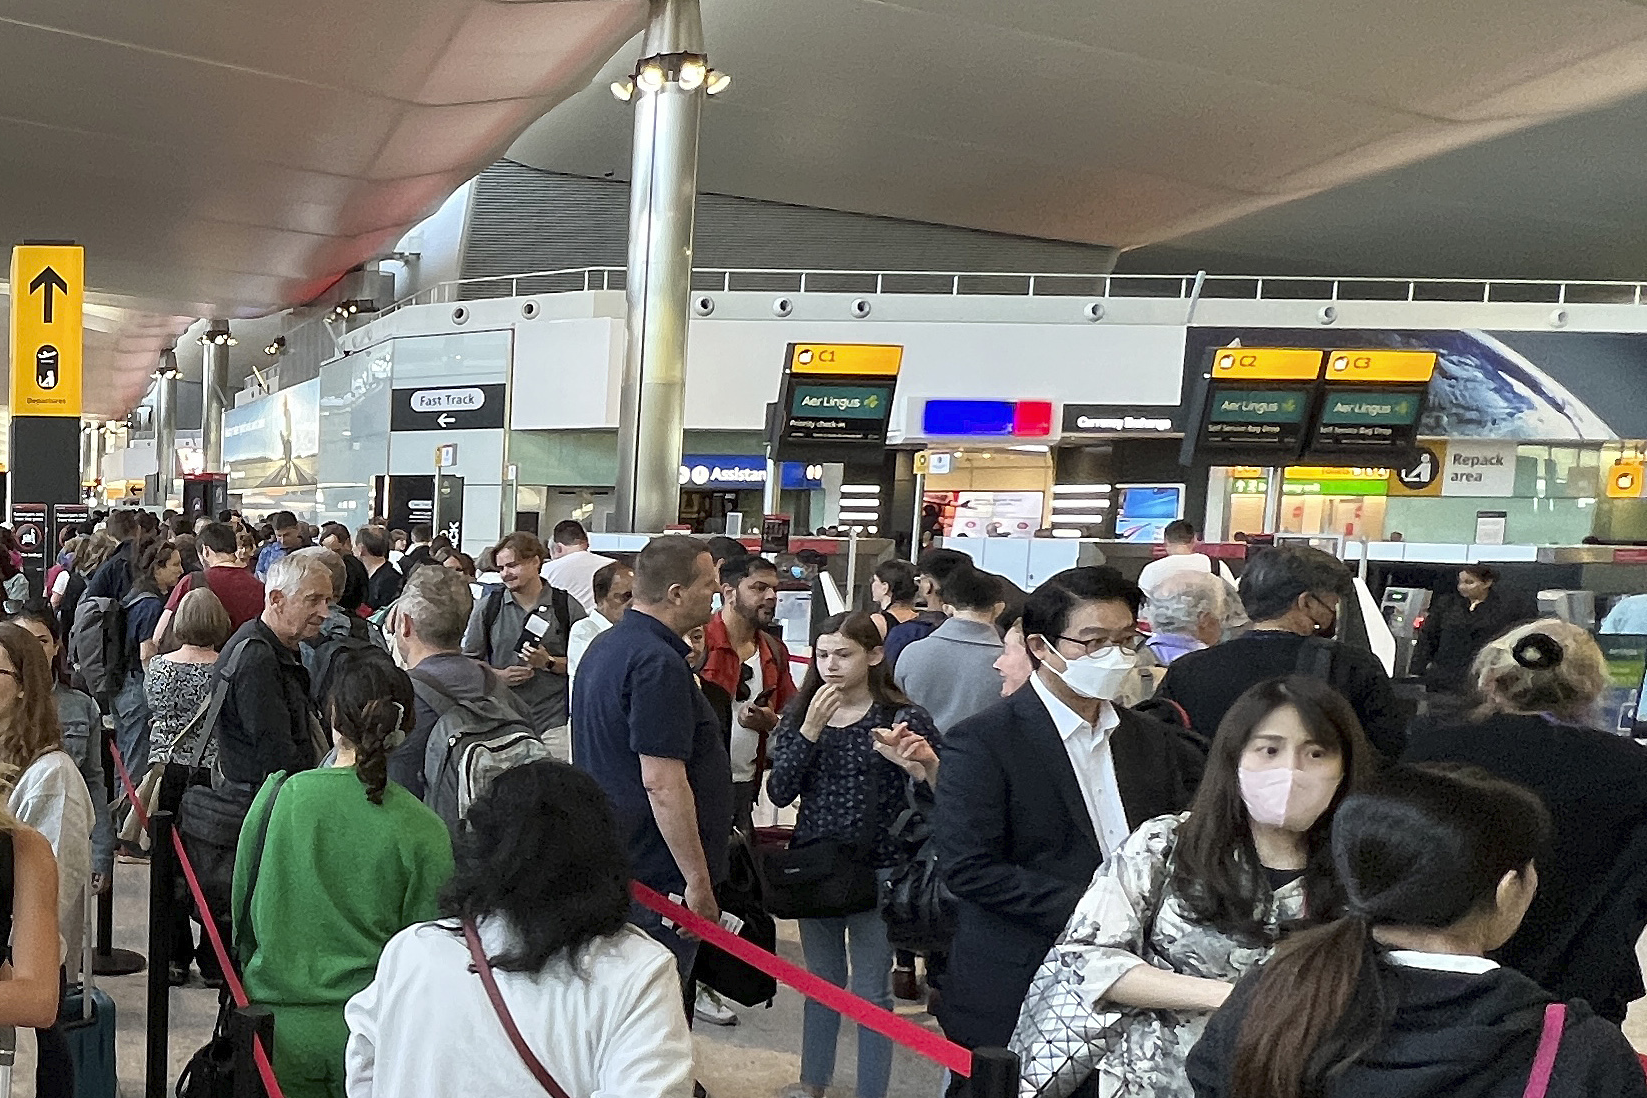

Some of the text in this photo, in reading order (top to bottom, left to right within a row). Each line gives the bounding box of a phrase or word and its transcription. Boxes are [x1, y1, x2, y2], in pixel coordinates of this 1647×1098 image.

[818, 350, 836, 362] C1
[1239, 356, 1257, 367] C2
[1353, 357, 1371, 369] C3
[419, 393, 475, 407] Fast Track
[801, 396, 861, 411] Aer Lingus
[1452, 453, 1504, 468] Repack
[709, 466, 767, 482] Assistan
[1450, 472, 1483, 482] area
